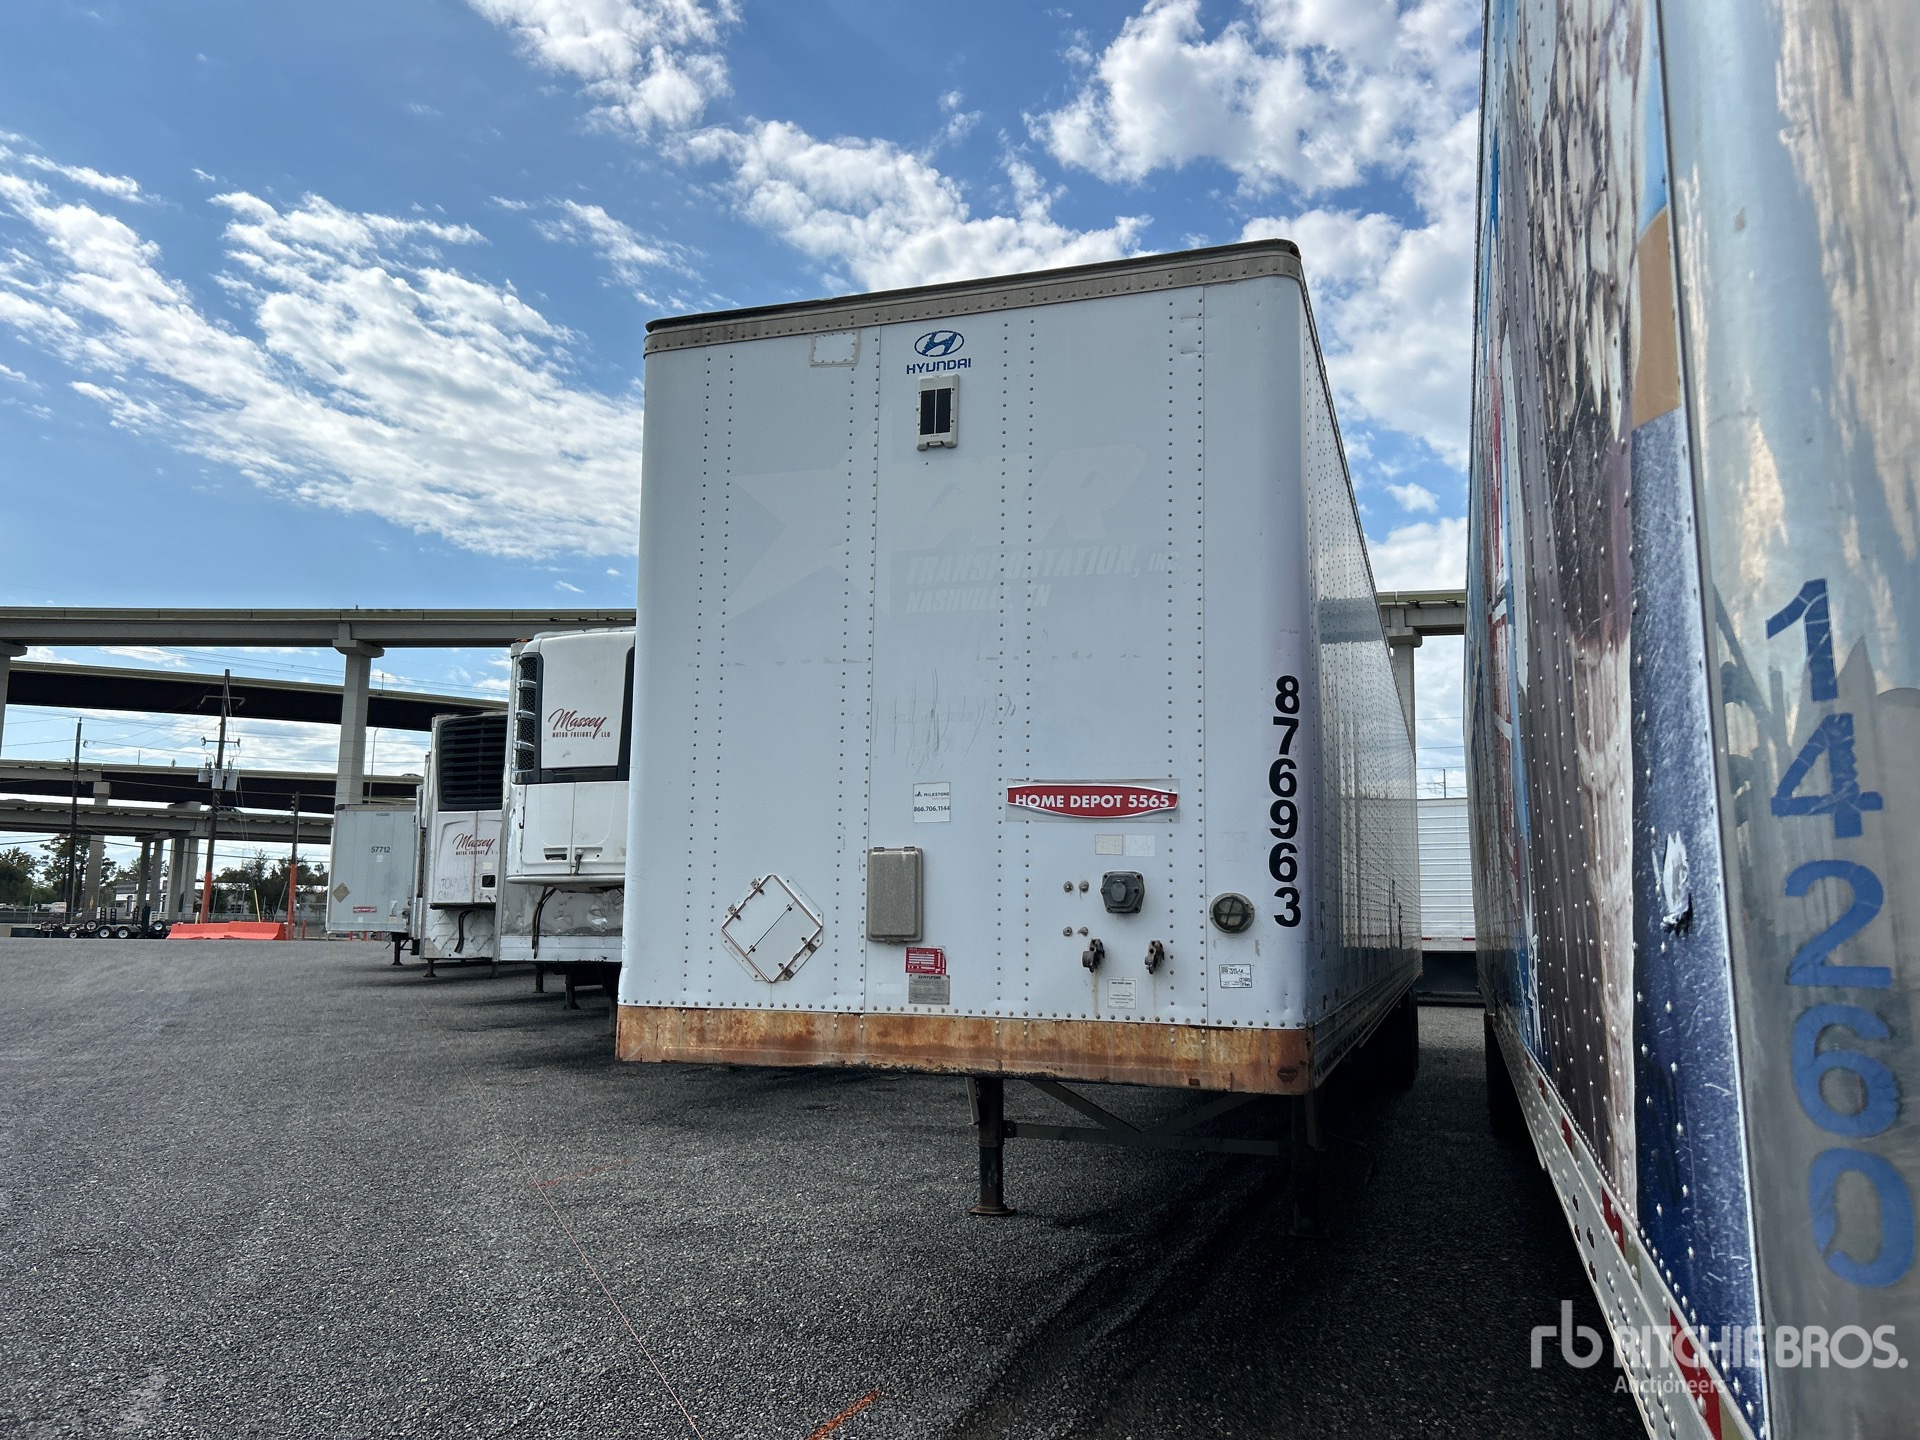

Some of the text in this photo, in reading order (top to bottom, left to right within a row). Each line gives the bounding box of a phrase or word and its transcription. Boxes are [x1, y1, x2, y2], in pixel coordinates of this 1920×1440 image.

[906, 358, 972, 374] HYUNDAI
[548, 708, 607, 740] Massey
[1015, 795, 1170, 808] HOME DEPOT 5565
[1268, 675, 1301, 928] 876963
[452, 833, 496, 855] Massey
[1765, 578, 1915, 1288] 14260
